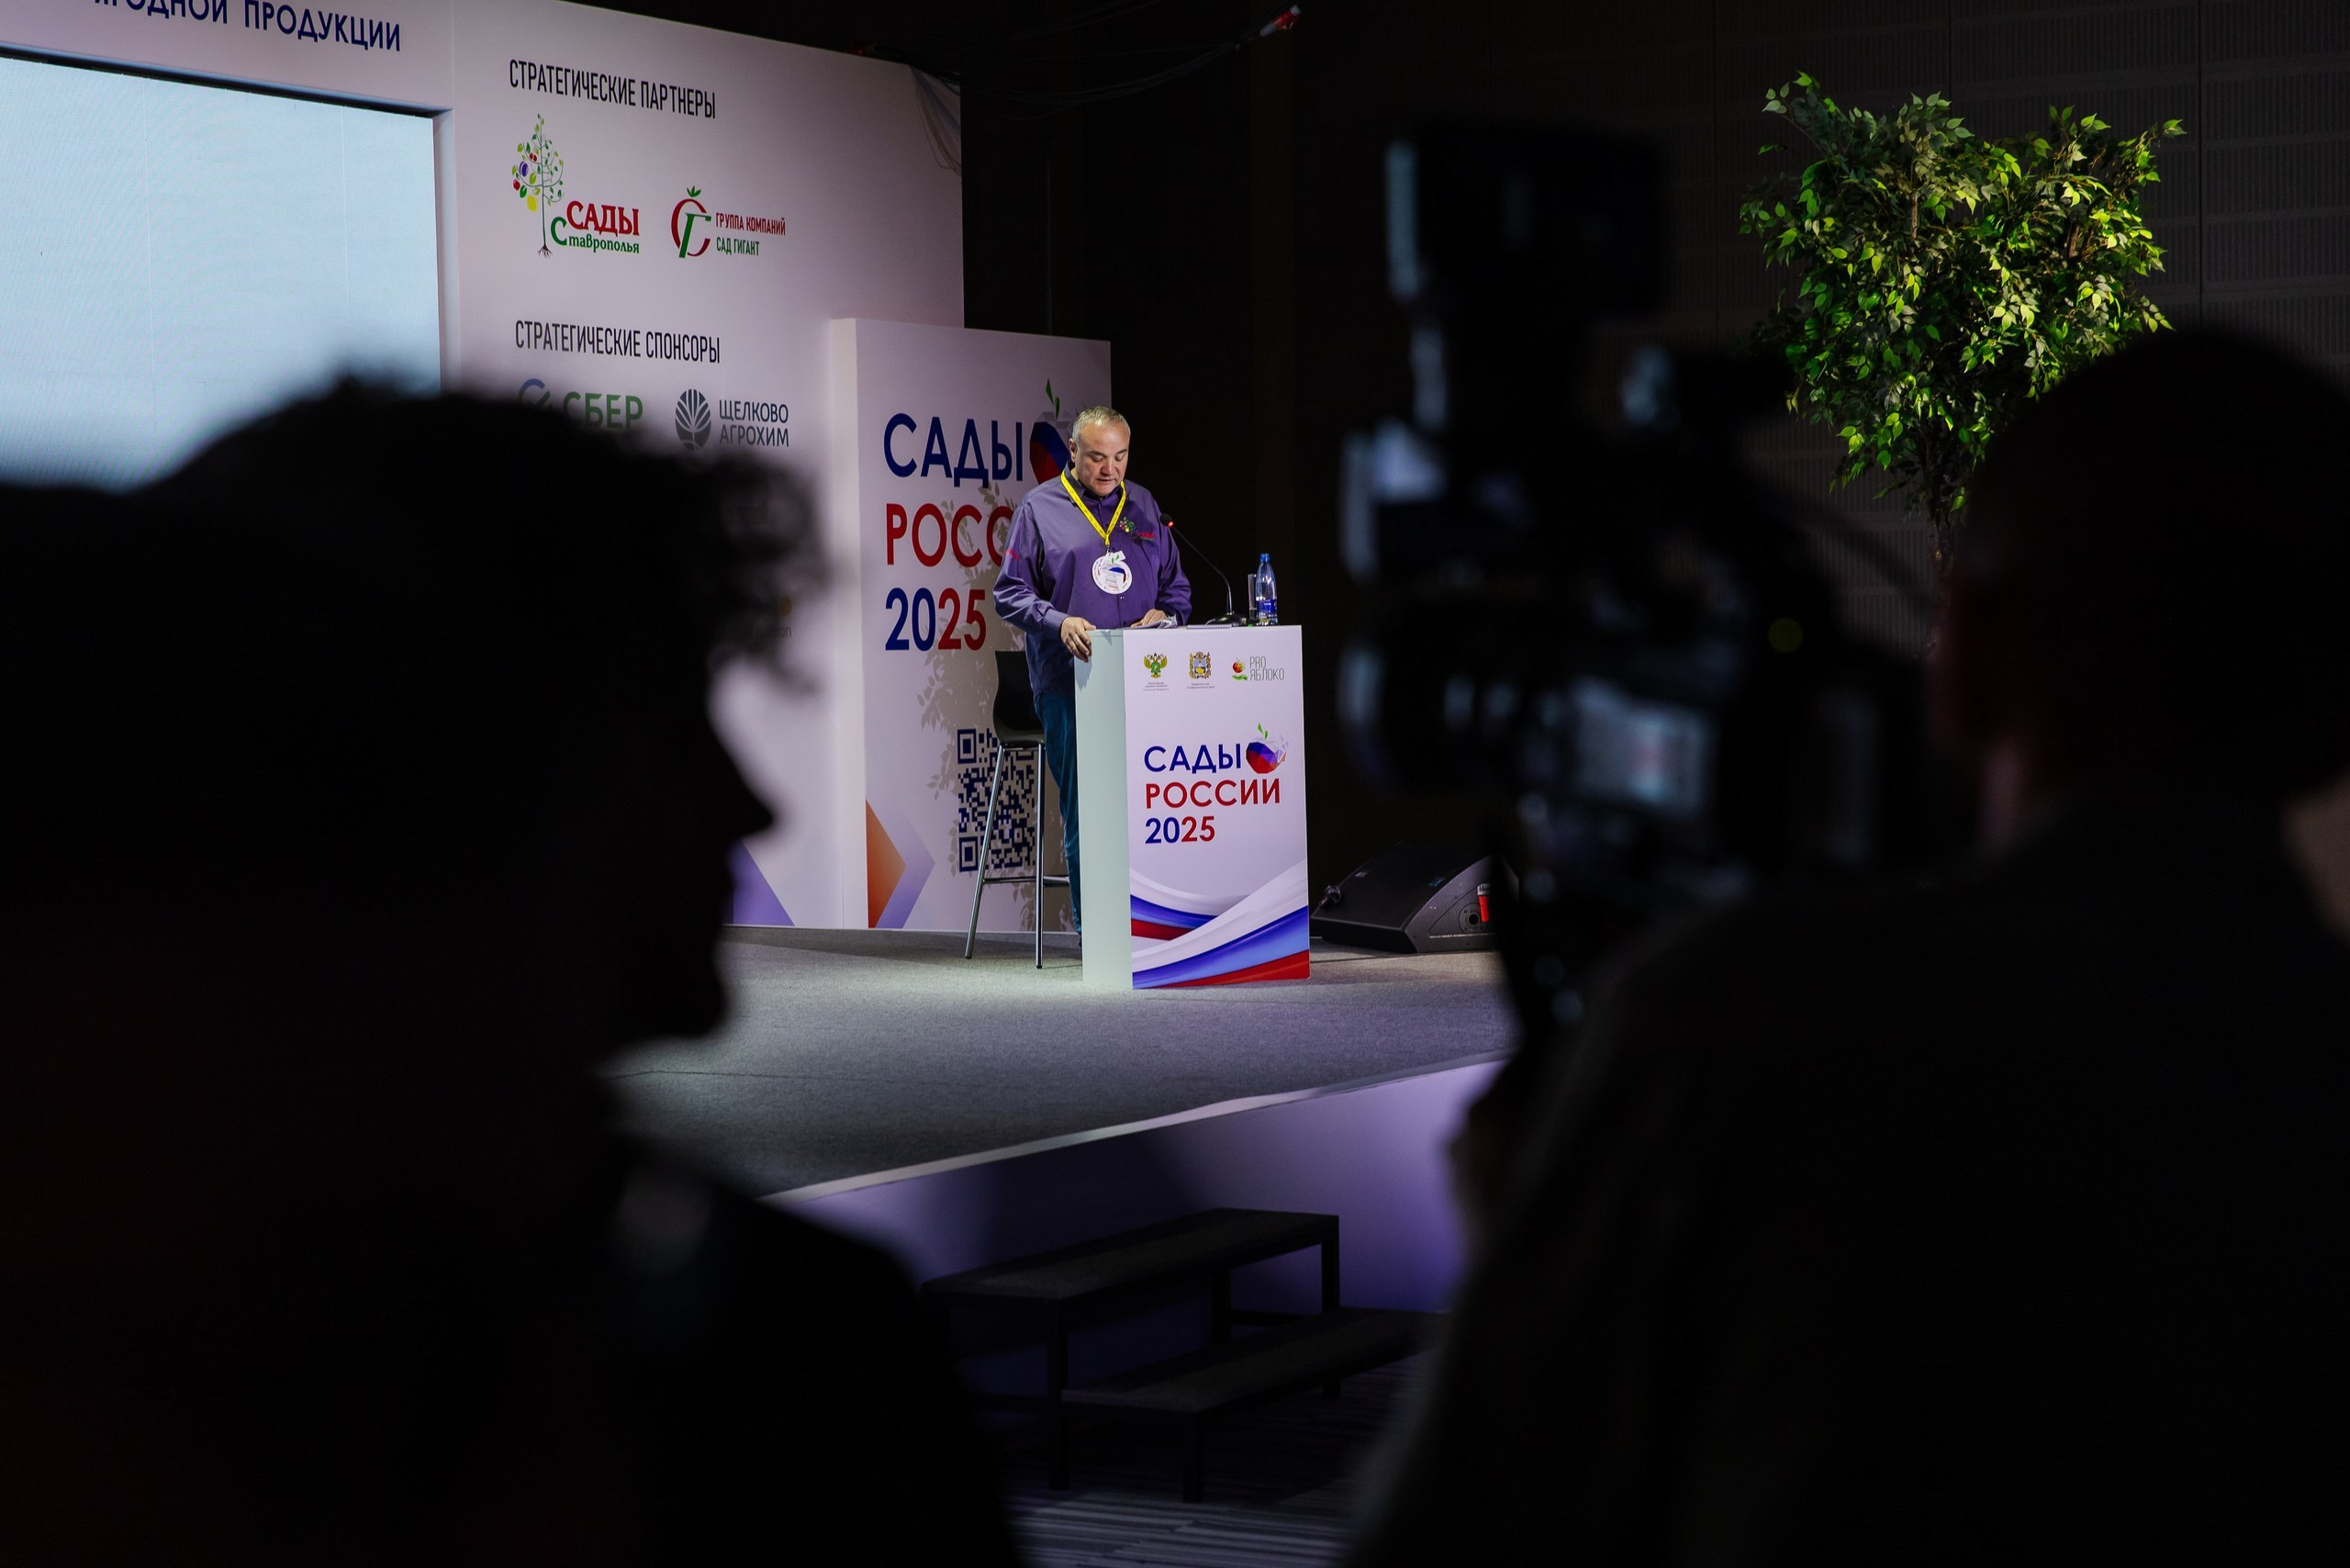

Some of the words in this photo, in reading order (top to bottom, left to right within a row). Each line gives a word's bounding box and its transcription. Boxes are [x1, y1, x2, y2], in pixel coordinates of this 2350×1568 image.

[95, 0, 228, 25] ДНОЙ
[244, 0, 400, 51] ПРОДУКЦИИ
[509, 59, 636, 106] СТРАТЕГИЧЕСКИЕ
[641, 81, 716, 119] ПАРТНЕРЫ
[566, 200, 640, 238] САДЫ
[715, 212, 744, 230] ГРУППА
[745, 217, 786, 236] КОМПАНИЙ
[716, 236, 732, 253] САД
[733, 240, 760, 256] ГИГАНТ
[515, 320, 641, 357] СТРАТЕГИЧЕСКИЕ
[645, 331, 720, 364] СПОНСОРЫ
[563, 391, 643, 431] СБЕР
[719, 399, 789, 423] ЩЕЛКОВО
[719, 424, 789, 447] АГРОХИМ
[883, 413, 1024, 488] САДЫ
[886, 503, 1013, 567] РОСС
[885, 588, 987, 651] 2025
[1249, 655, 1267, 669] PRO
[1249, 667, 1285, 681] ЯБЛОКО
[1144, 744, 1242, 774] САДЫ
[1146, 778, 1281, 809] РОССИИ
[1145, 815, 1215, 844] 2025
